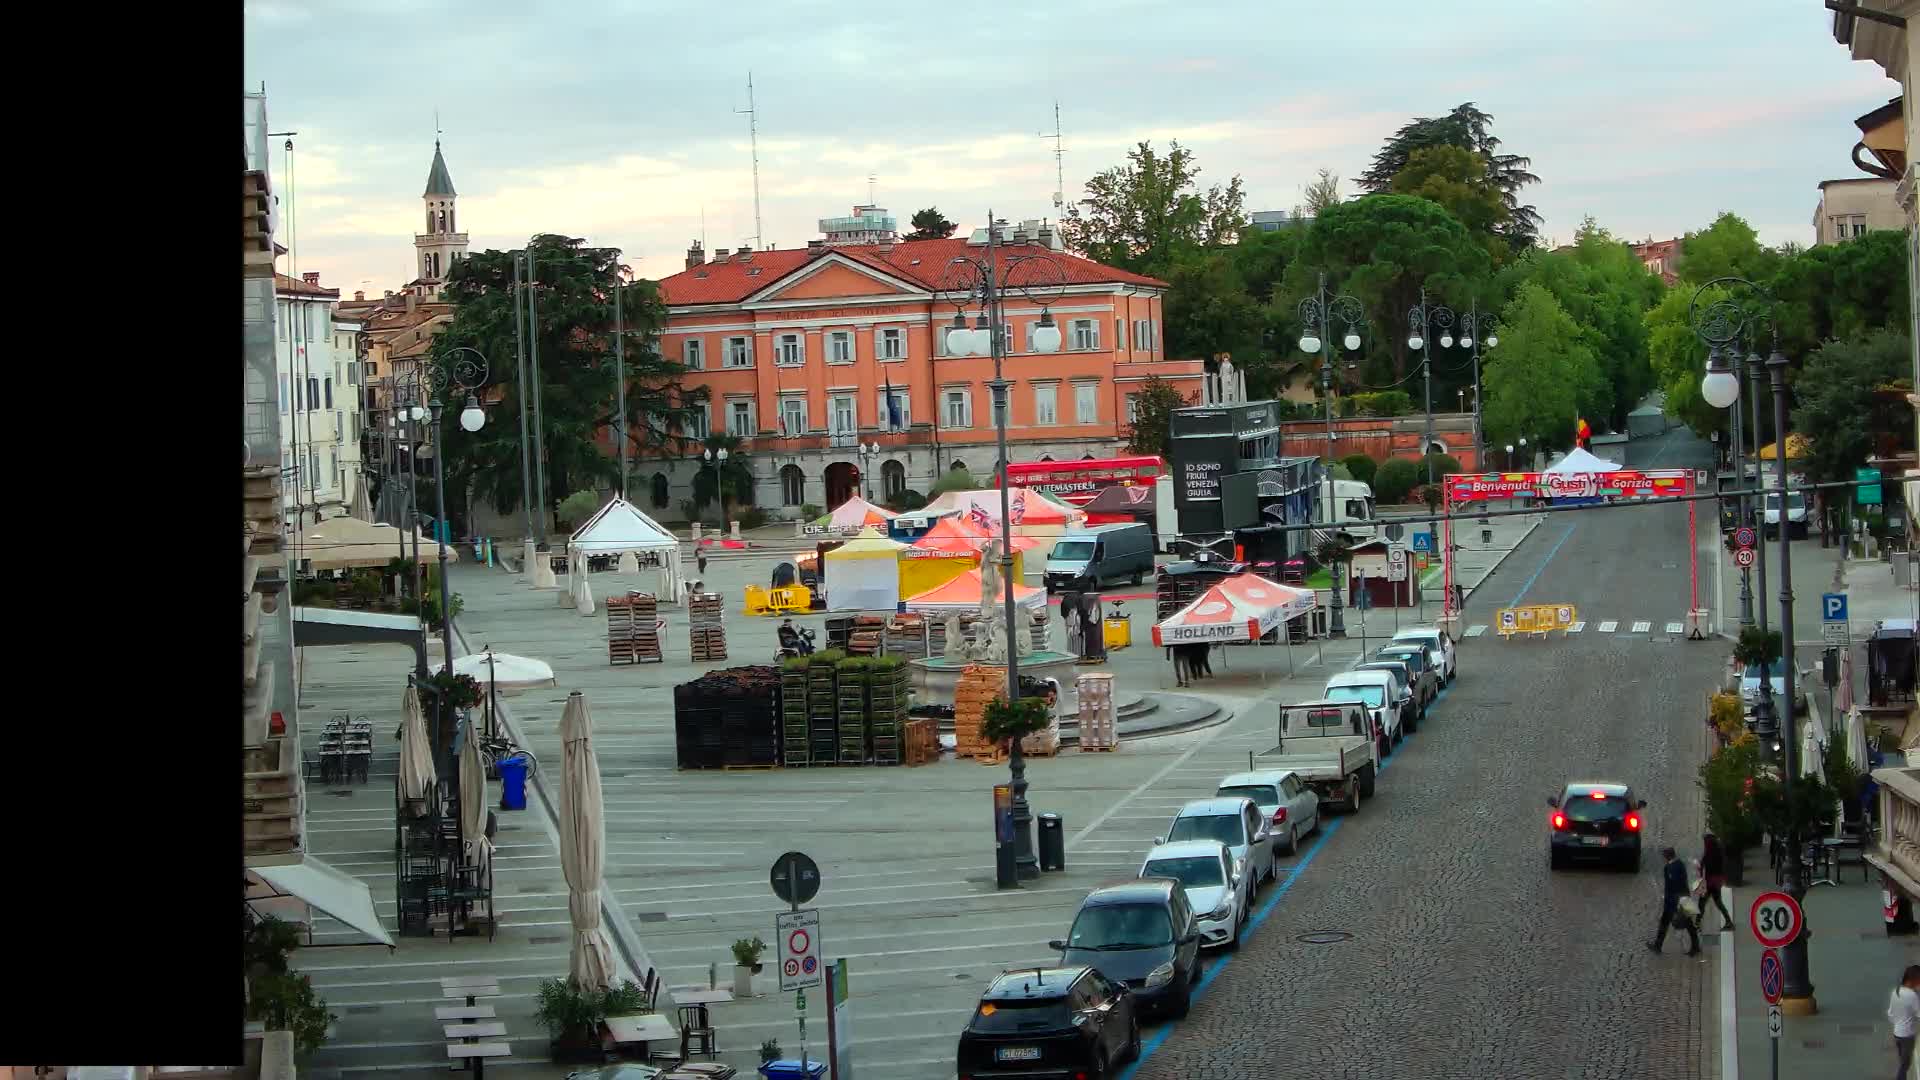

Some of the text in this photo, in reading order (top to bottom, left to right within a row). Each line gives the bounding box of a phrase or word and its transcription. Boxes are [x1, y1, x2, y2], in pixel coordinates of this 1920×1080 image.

[1185, 463, 1221, 471] IO SONO
[1186, 472, 1208, 480] FRIULI
[1186, 480, 1219, 488] VENEZIA
[1472, 480, 1532, 492] Benvenuti
[1612, 478, 1653, 488] Gorizia
[1187, 489, 1212, 497] GIULIA
[1740, 553, 1750, 562] 20
[1828, 598, 1842, 617] P
[1174, 626, 1235, 639] HOLLAND
[1760, 907, 1789, 931] 30
